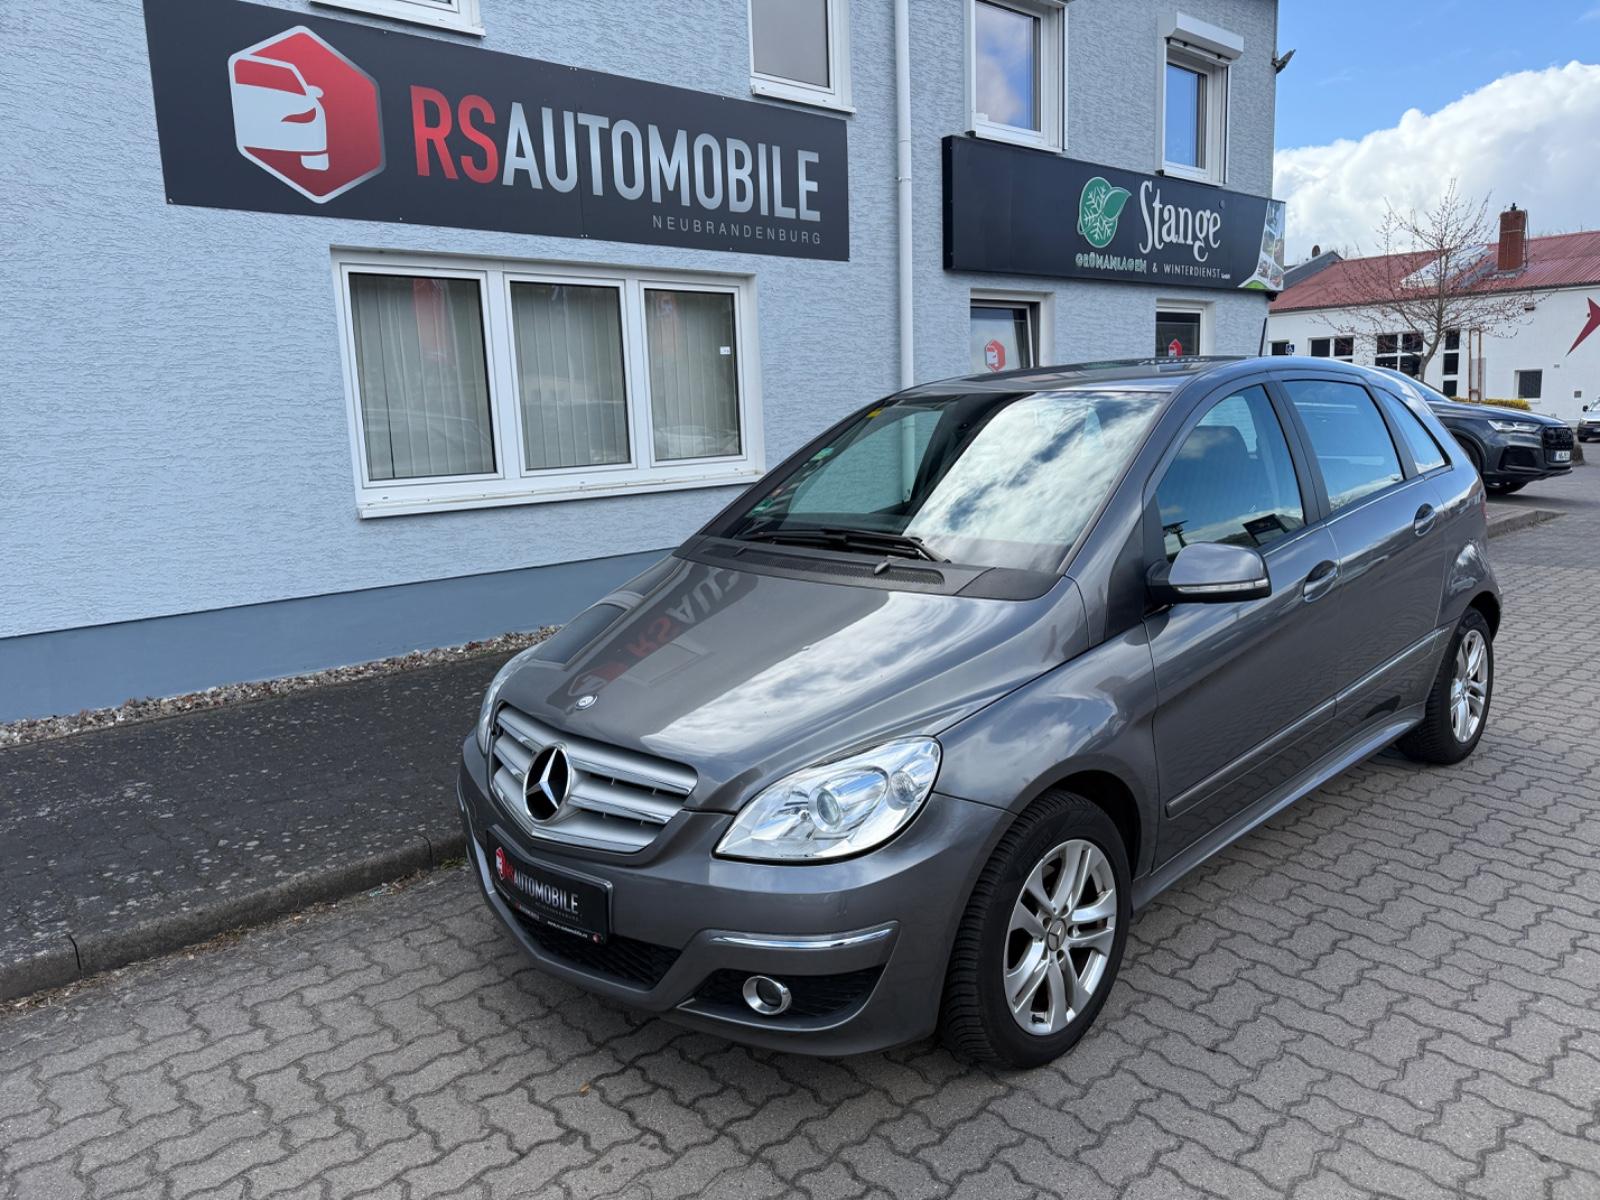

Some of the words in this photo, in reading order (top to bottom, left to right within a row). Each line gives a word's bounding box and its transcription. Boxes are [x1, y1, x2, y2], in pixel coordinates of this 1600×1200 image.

[410, 84, 821, 222] RSAUTOMOBILE
[652, 214, 822, 245] NEUBRANDENBURG
[1138, 180, 1221, 262] Stange
[1152, 262, 1158, 273] &
[1163, 263, 1221, 279] WINTERDIENST
